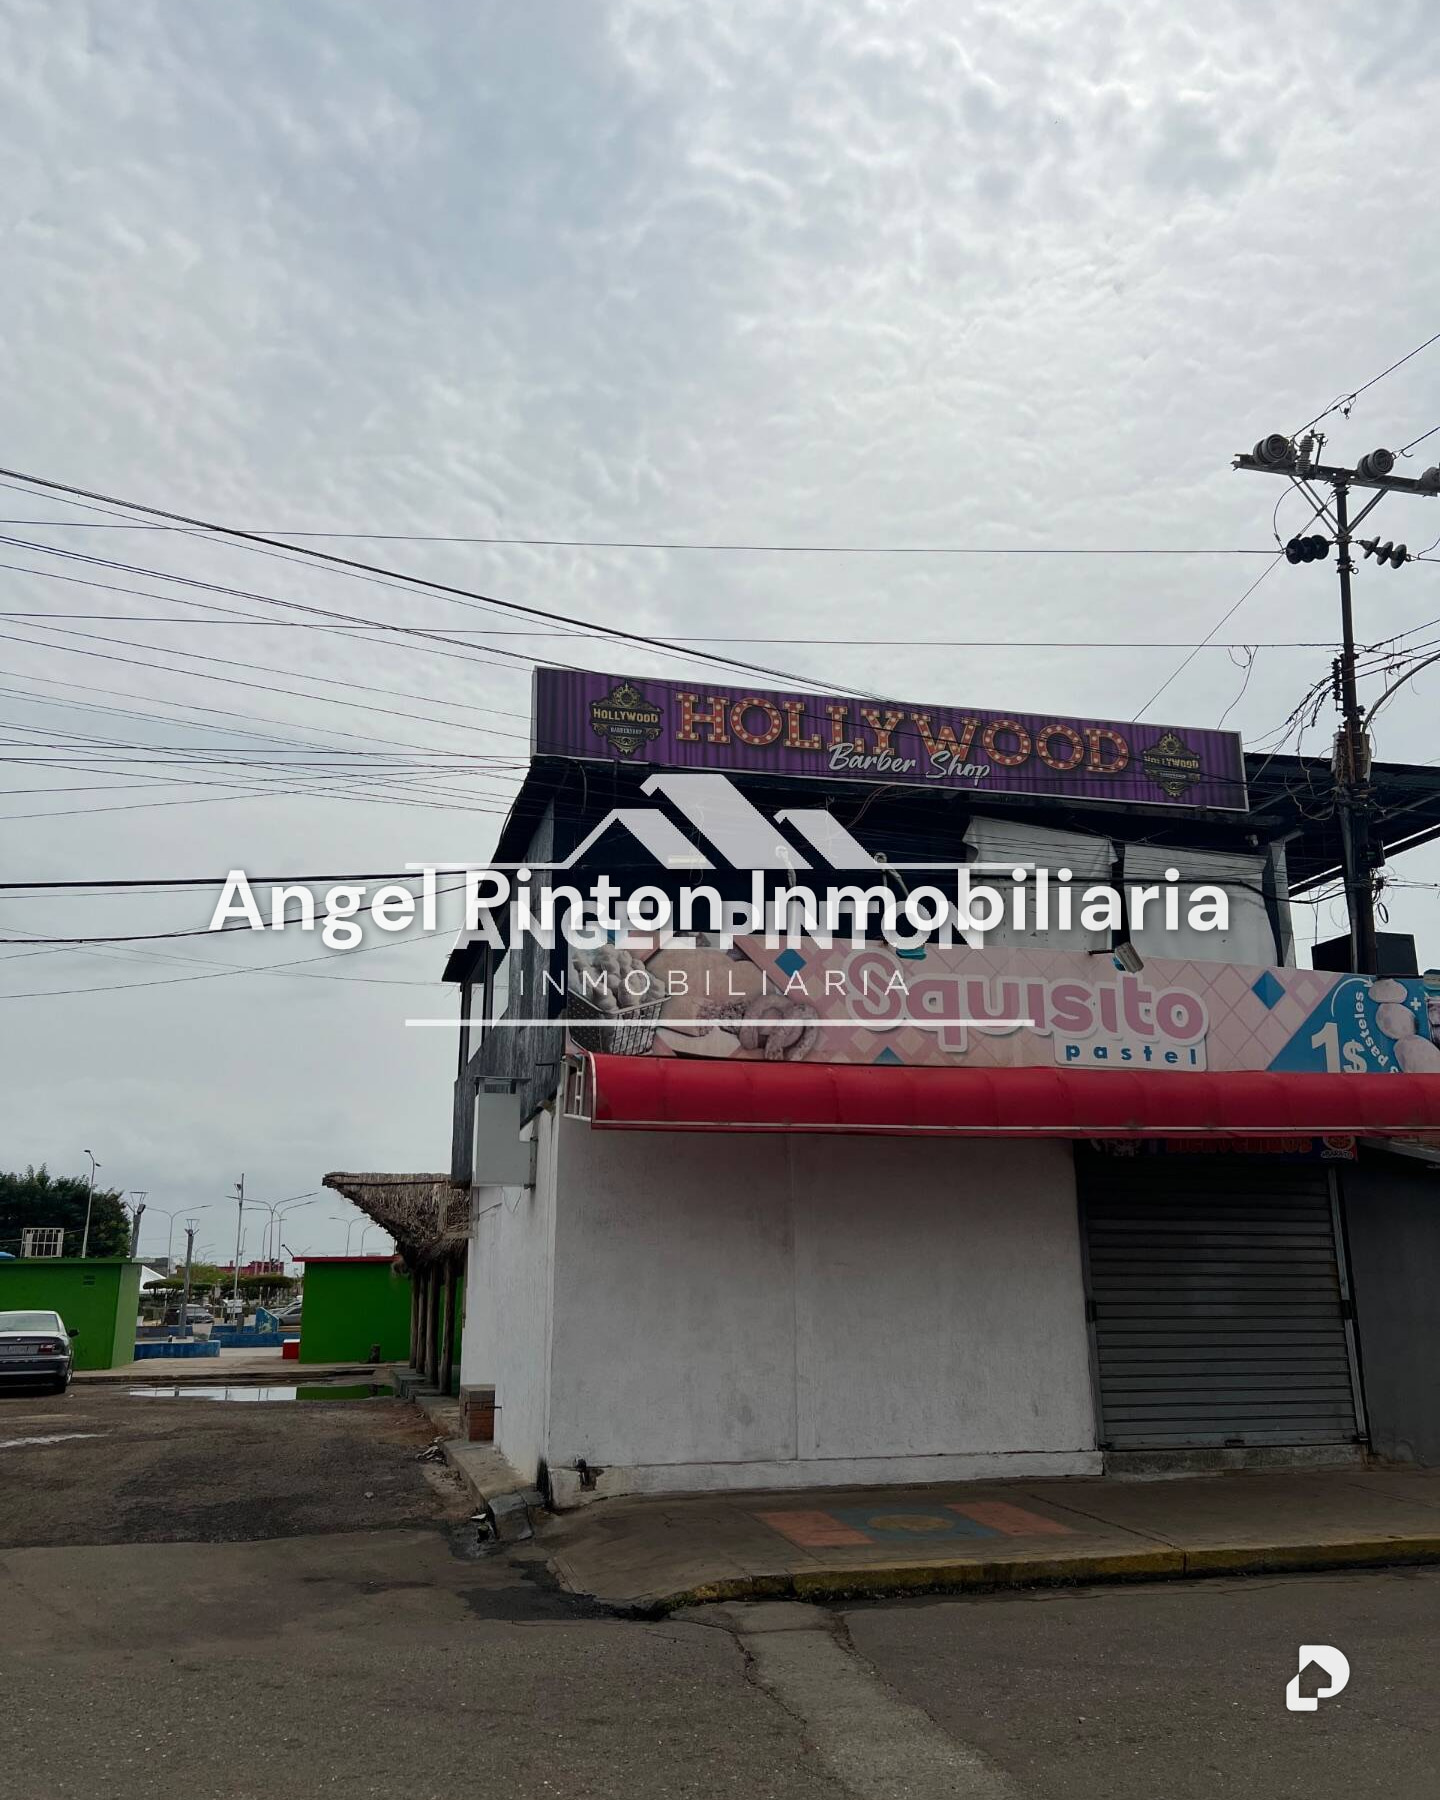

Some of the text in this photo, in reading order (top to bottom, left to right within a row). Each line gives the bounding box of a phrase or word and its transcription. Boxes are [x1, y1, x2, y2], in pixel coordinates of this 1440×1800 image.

[593, 708, 659, 724] HOLLYWOOD
[675, 692, 1130, 773] HOLLYWOOD
[828, 743, 990, 787] Barber Shop
[847, 952, 1204, 1046] Squisito
[1354, 991, 1389, 1067] pasteles
[1065, 1045, 1197, 1064] pastel
